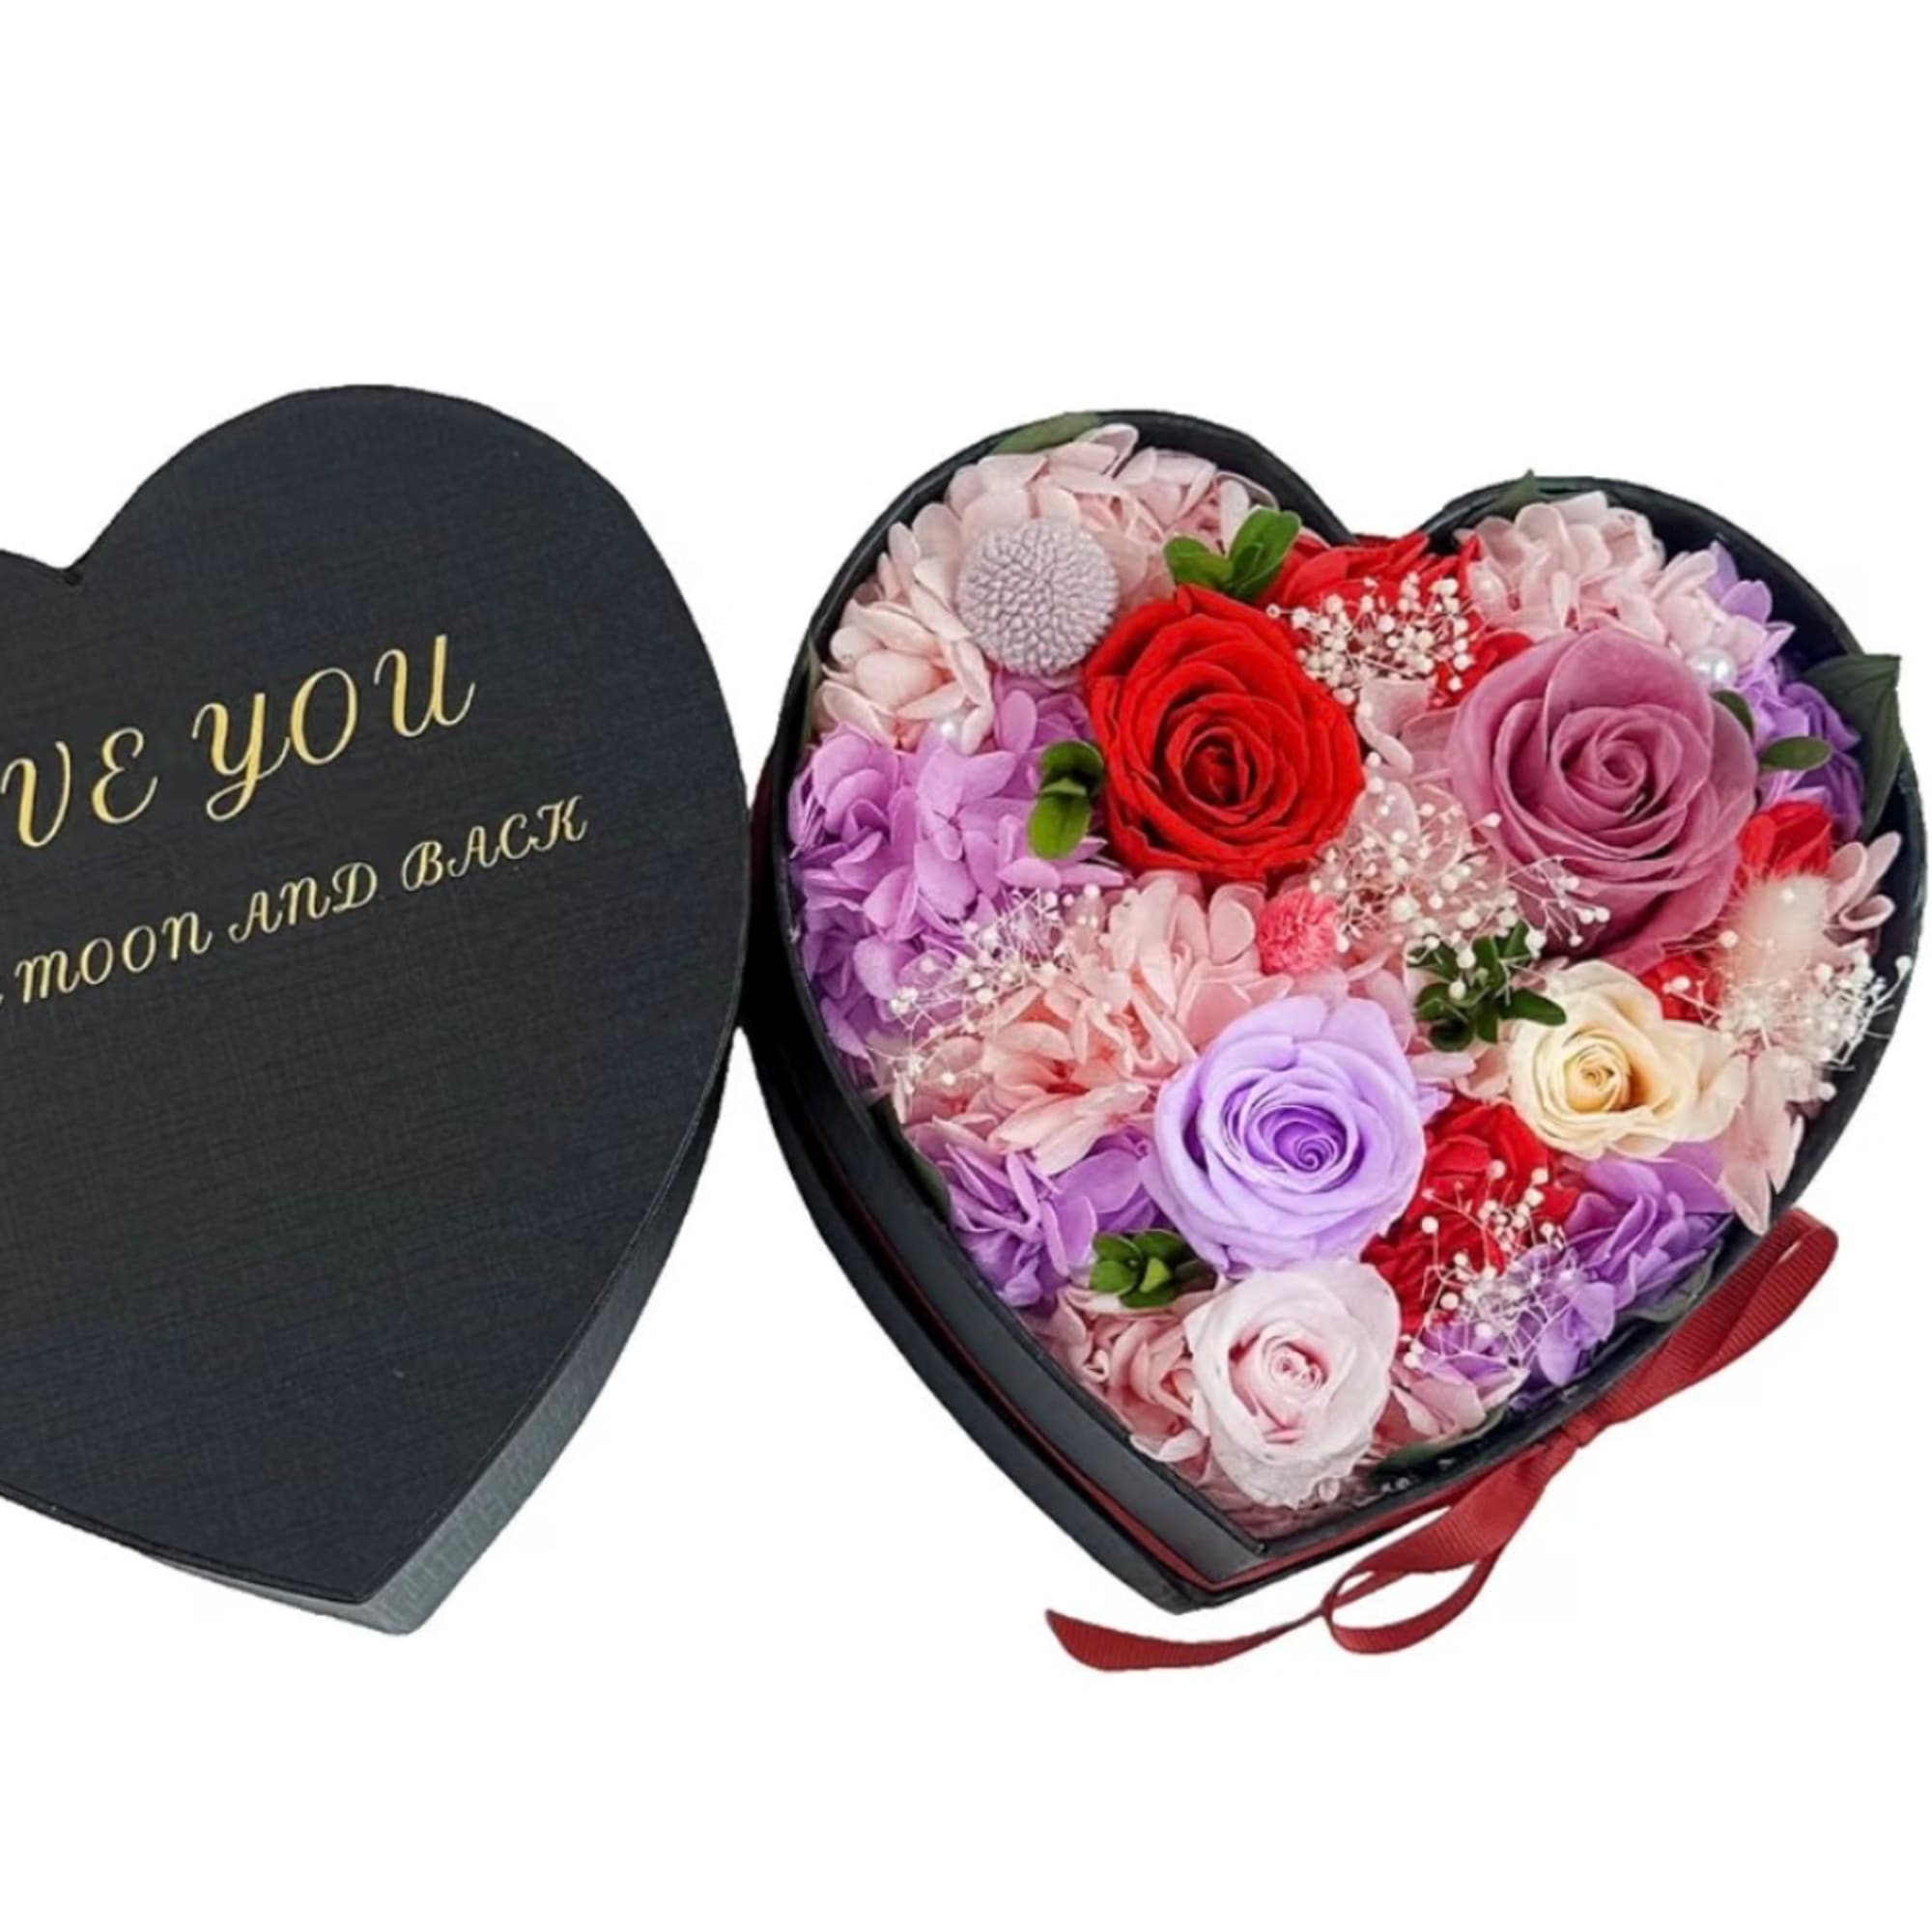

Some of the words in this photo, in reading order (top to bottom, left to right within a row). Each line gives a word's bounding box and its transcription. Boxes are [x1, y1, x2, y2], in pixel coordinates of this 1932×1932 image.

[192, 635, 475, 821] YOU
[14, 912, 213, 1004] MOON
[228, 862, 378, 942] AND
[401, 795, 587, 891] BACK
